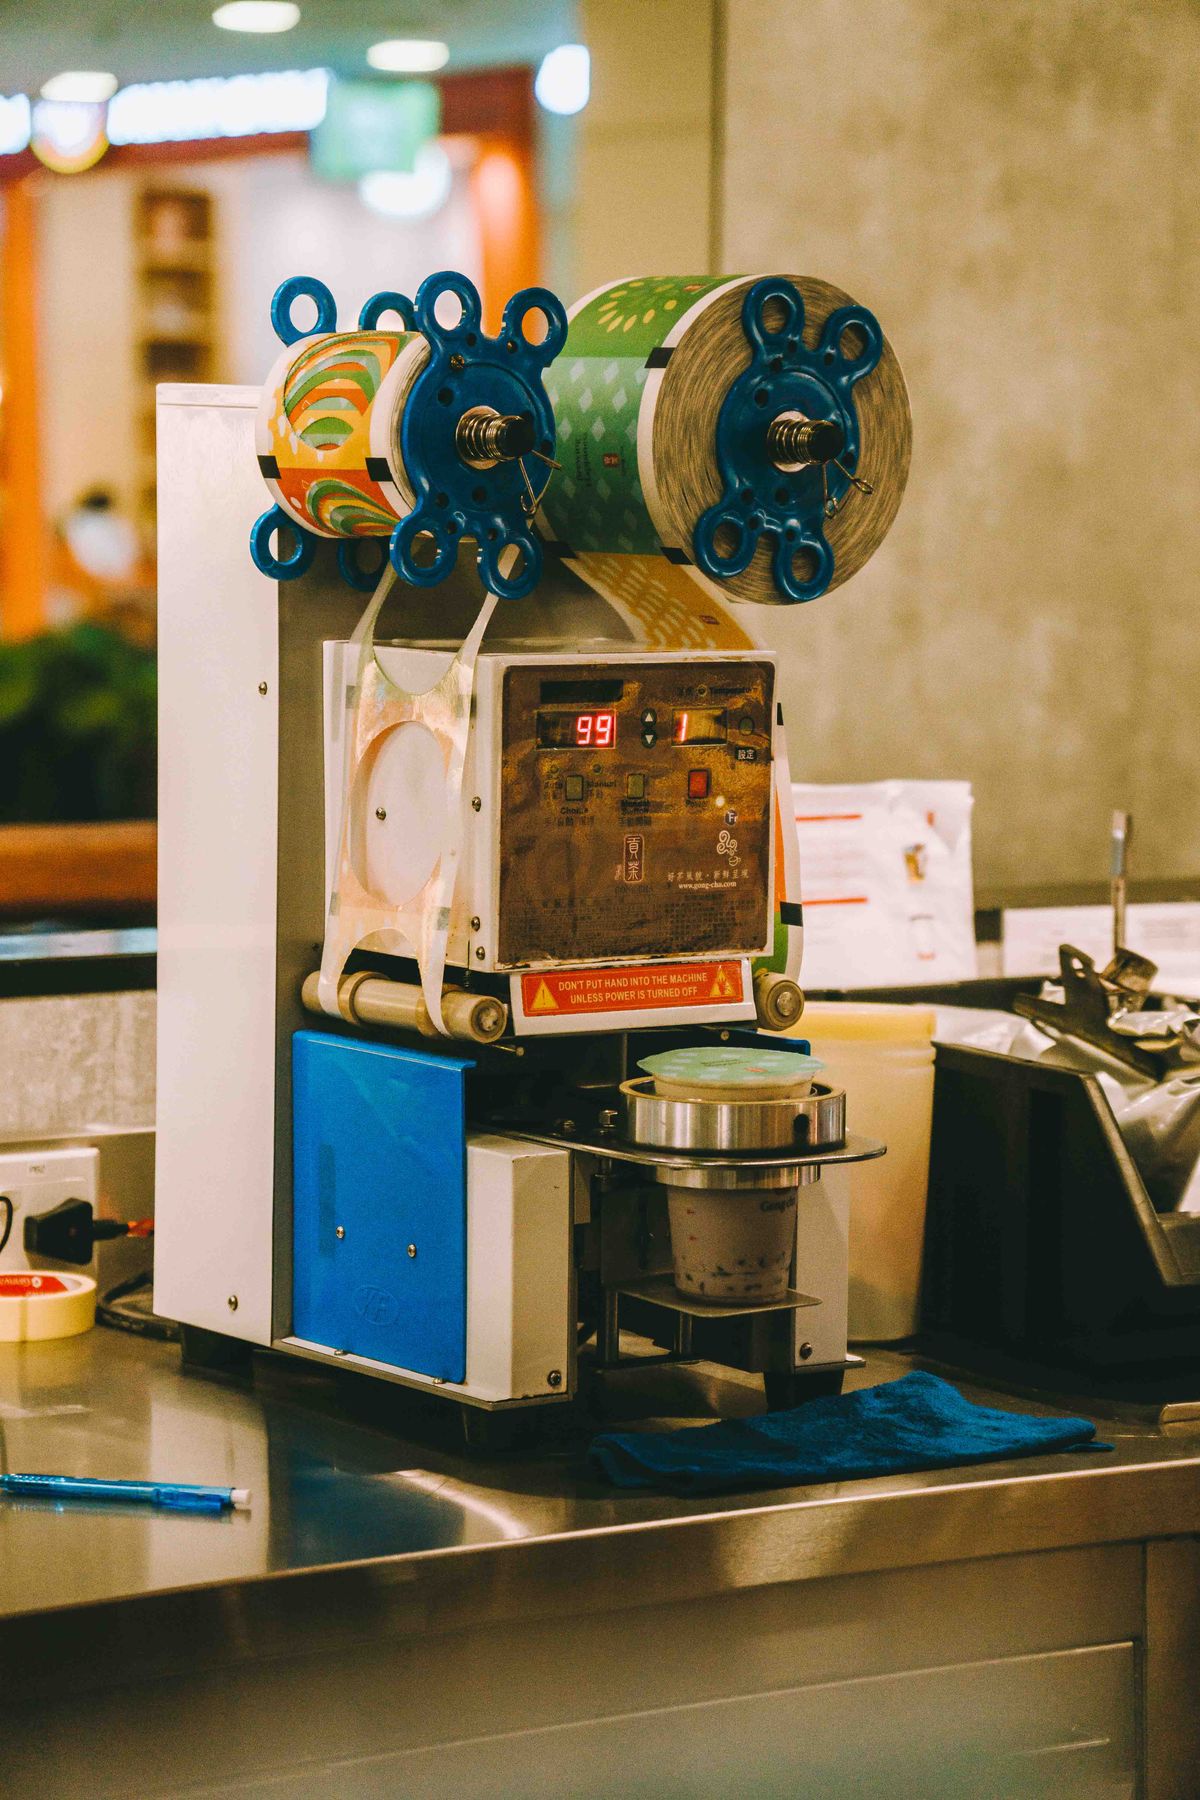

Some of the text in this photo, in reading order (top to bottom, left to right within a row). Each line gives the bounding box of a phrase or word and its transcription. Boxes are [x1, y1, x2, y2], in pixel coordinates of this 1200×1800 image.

[577, 715, 612, 745] 99
[737, 749, 754, 760] 設定
[626, 836, 641, 881] 貢茶
[678, 881, 737, 890] www.gong-cha.com
[558, 972, 708, 992] DON'T PUT HAND INTO THE MACHINE
[570, 985, 698, 1004] UNLESS POWER IS TURNED OFF
